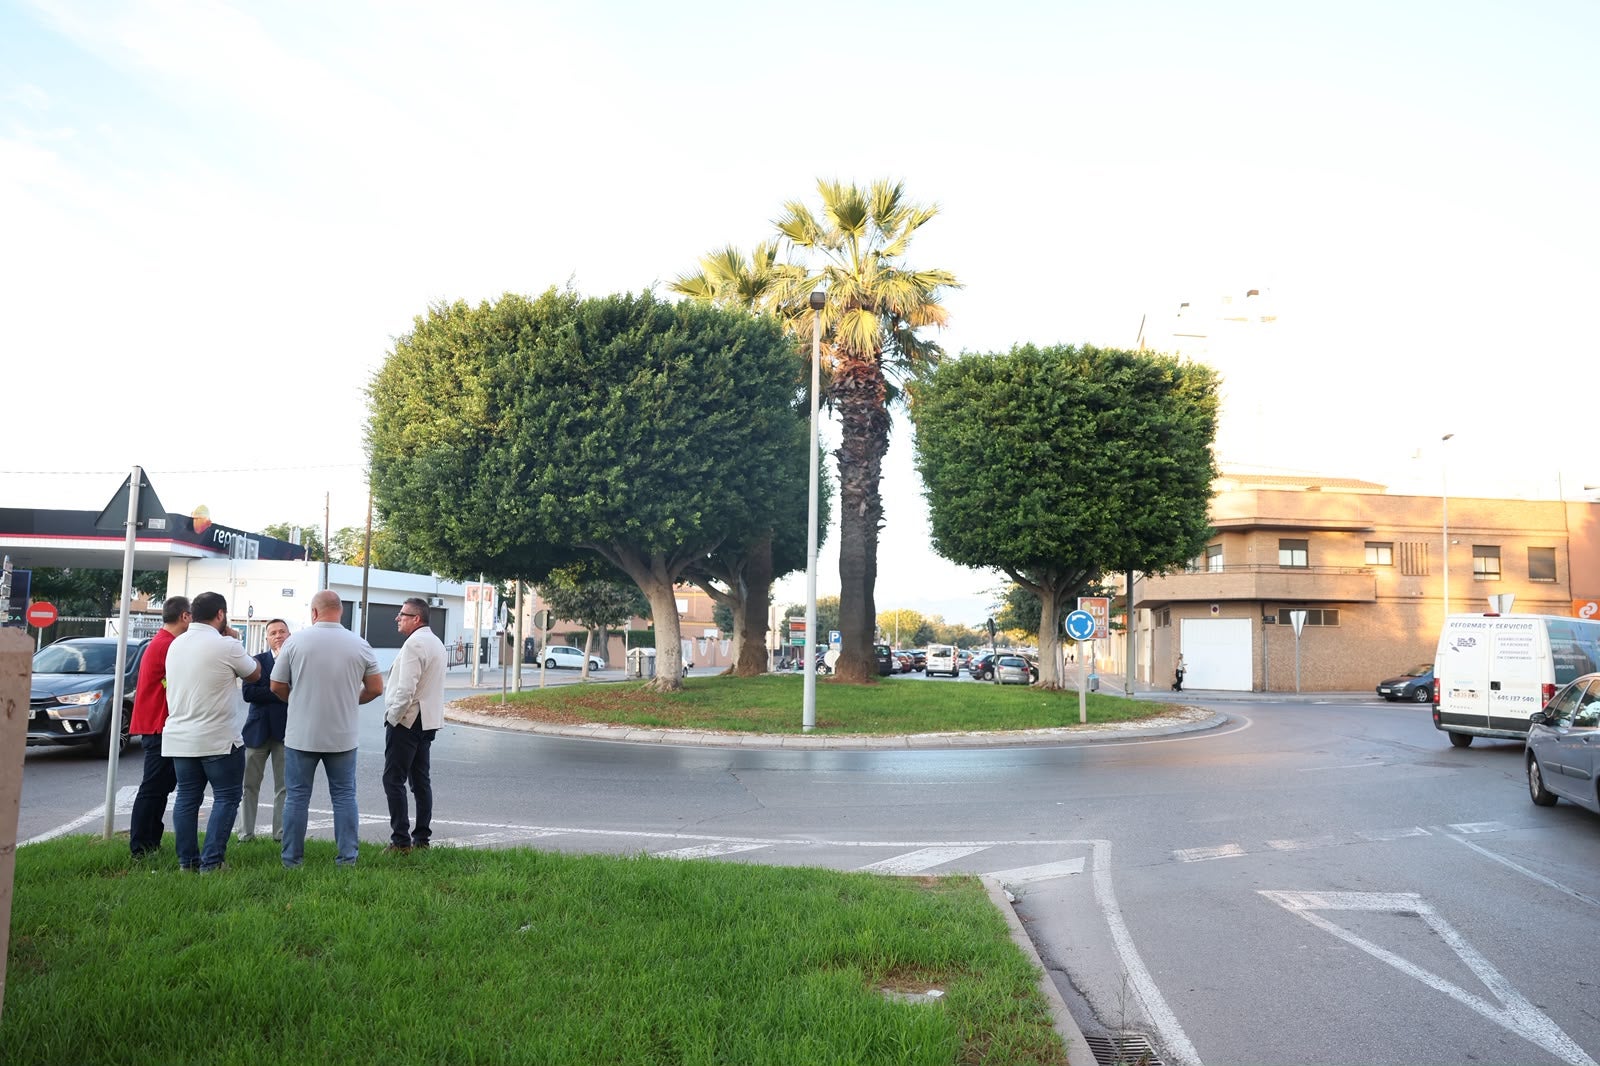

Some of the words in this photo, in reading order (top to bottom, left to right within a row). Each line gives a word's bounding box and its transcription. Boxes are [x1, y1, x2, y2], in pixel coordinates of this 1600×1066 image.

[213, 529, 247, 547] rep
[1450, 622, 1487, 630] REFORMAS
[831, 632, 840, 642] P
